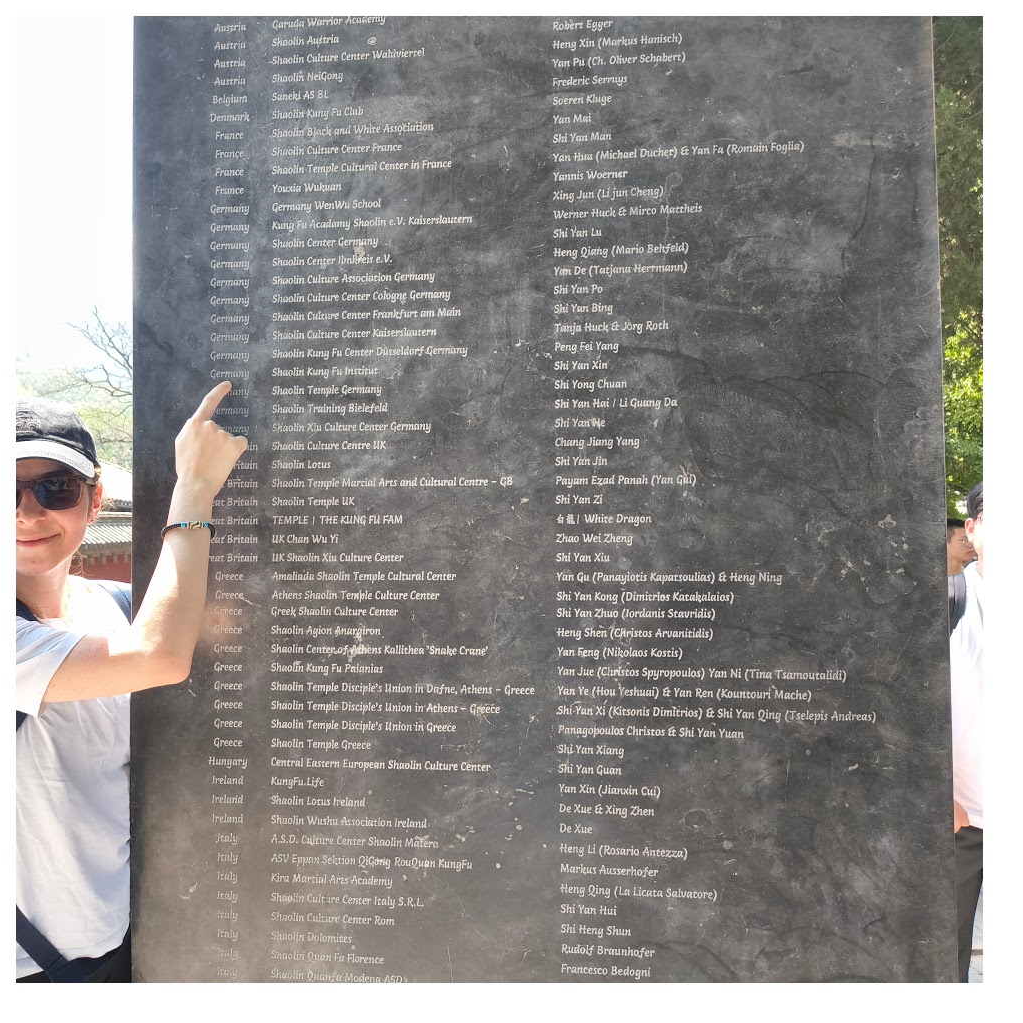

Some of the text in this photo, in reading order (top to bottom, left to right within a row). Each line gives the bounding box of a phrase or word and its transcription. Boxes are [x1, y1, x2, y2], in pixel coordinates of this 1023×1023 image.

[552, 18, 614, 31] Robert Egger
[214, 39, 247, 50] Austria
[552, 32, 683, 51] Heng Xin (Markus Hanisch)
[552, 57, 570, 67] Yan
[572, 56, 585, 66] Pu
[609, 54, 637, 64] Oliver
[272, 71, 344, 83] Shaolin NeiGong
[552, 75, 589, 86] Frederic
[552, 93, 612, 106] Soeren Kluge
[209, 112, 250, 122] Denmark
[272, 106, 365, 120] Shaolin Kung Fu Club
[215, 148, 244, 158] France
[272, 142, 402, 156] Shaolin Culture Center France
[552, 168, 629, 180] Yannis Woerner
[272, 182, 342, 192] Youxia Wukuan
[272, 199, 382, 213] Germany WenWu School
[553, 208, 588, 219] Werner
[591, 207, 615, 217] Huck
[629, 205, 657, 216] Mirco
[660, 203, 703, 214] Mattheis
[210, 222, 251, 234] Germany
[272, 219, 294, 231] Kung
[296, 218, 307, 228] Fu
[353, 216, 386, 227] Shaolin
[408, 214, 473, 225] Kaiserslautern
[210, 240, 251, 252] Germany
[272, 236, 379, 249] Shaolin Center Germany
[272, 311, 304, 321] Shaolin
[307, 310, 339, 320] Culture
[341, 309, 370, 319] Center
[372, 308, 417, 321] Frankfurt
[437, 307, 461, 317] Main
[272, 327, 437, 339] Shaolin Culture Center Kaiserslautern
[554, 322, 581, 334] Tanja
[584, 321, 608, 331] Huck
[621, 321, 643, 333] Jörg
[646, 320, 669, 330] Roth
[554, 341, 620, 353] Peng Fei Yang
[272, 384, 383, 396] Shaolin Temple Germany
[272, 403, 388, 415] Shaolin Training Bielefeld
[554, 436, 640, 449] Chang Jiang Yang
[555, 475, 697, 487] Payam Ezad Panah (Yan Gui)
[272, 496, 355, 508] Shaolin Temple UK
[555, 533, 634, 545] Zhao Wei Zheng
[272, 552, 405, 562] UK Shaolin Xiu Culture Center
[215, 571, 244, 580] Greece
[556, 571, 574, 581] Yan
[576, 571, 589, 581] Gu
[730, 572, 756, 584] Heng
[758, 572, 783, 584] Ning
[556, 591, 571, 600] Shi
[574, 591, 591, 601] Yan
[594, 591, 618, 603] Kong
[621, 591, 670, 603] (Dimitrios
[271, 605, 399, 616] Greek Shaolin Culture Center
[556, 608, 571, 617] Shi
[574, 608, 592, 617] Yan
[594, 608, 618, 617] Zhuo
[208, 756, 249, 768] Hungary
[271, 757, 491, 771] Central Eastern European Shaolin Culture Center
[212, 775, 245, 785] Ireland
[271, 776, 325, 788] KungFu.Life
[271, 795, 366, 807] Shaolin Lotus Ireland
[561, 864, 659, 878] Markus Ausserhofer
[561, 944, 656, 959] Rudolf Braunhofer
[561, 964, 652, 978] Francesco Bedogni
